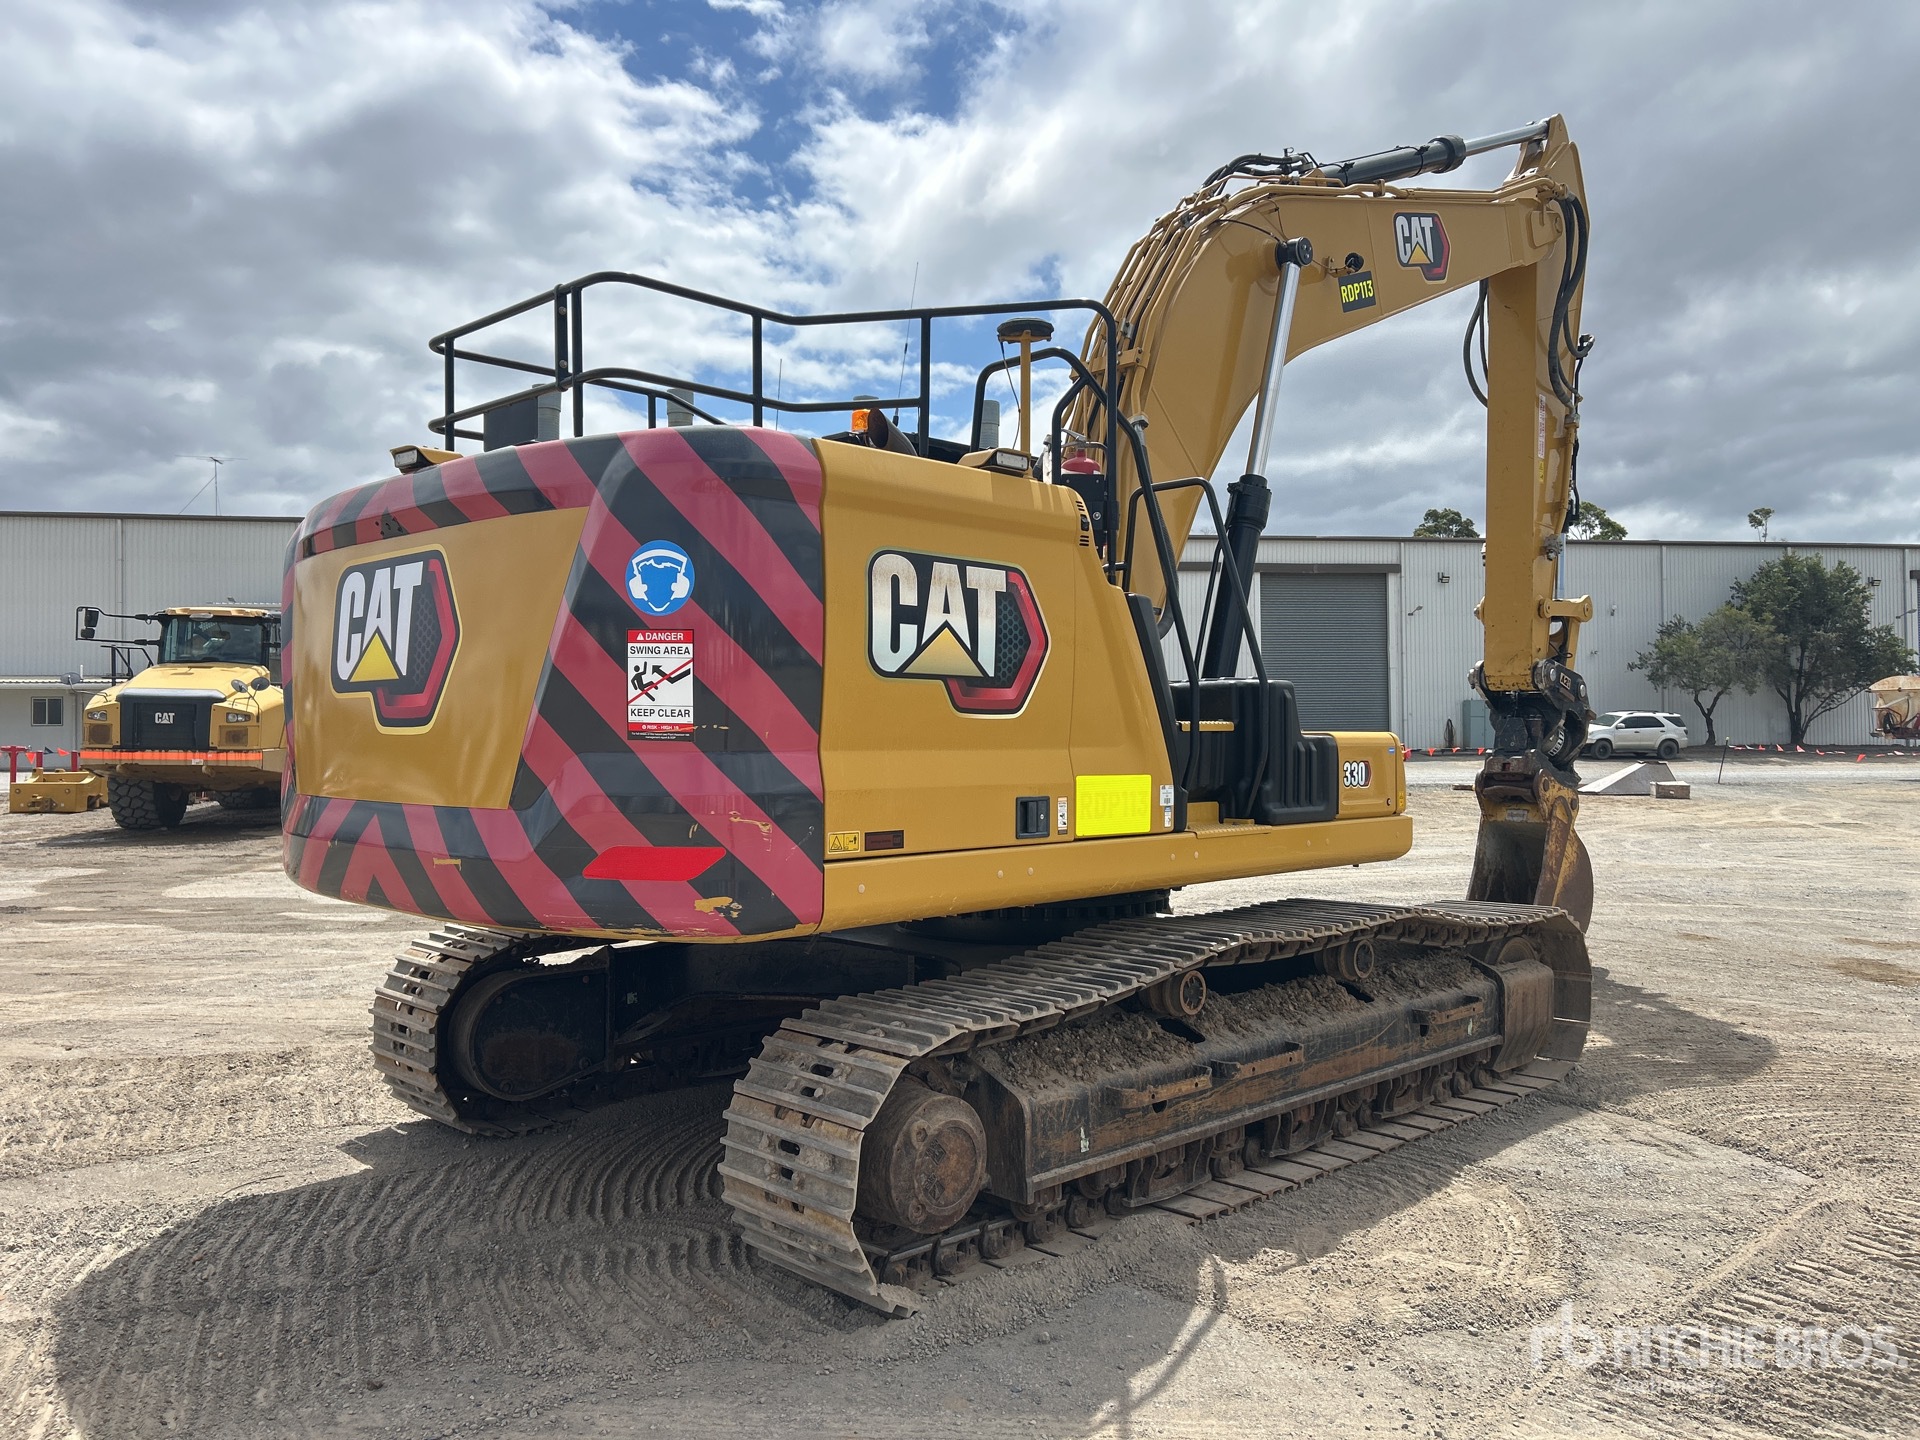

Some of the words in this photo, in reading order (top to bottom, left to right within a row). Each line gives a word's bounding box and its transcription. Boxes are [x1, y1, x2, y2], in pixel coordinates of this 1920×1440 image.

[1395, 215, 1434, 264] CAT
[1340, 279, 1374, 304] RDP113
[336, 560, 424, 681] CAT
[871, 553, 1007, 678] CAT
[645, 632, 684, 641] DANGER
[629, 645, 661, 655] SWING
[663, 646, 691, 656] AREA
[155, 712, 175, 724] CAT
[630, 708, 656, 717] KEEP
[657, 708, 690, 718] CLEAR
[1343, 761, 1366, 786] 330
